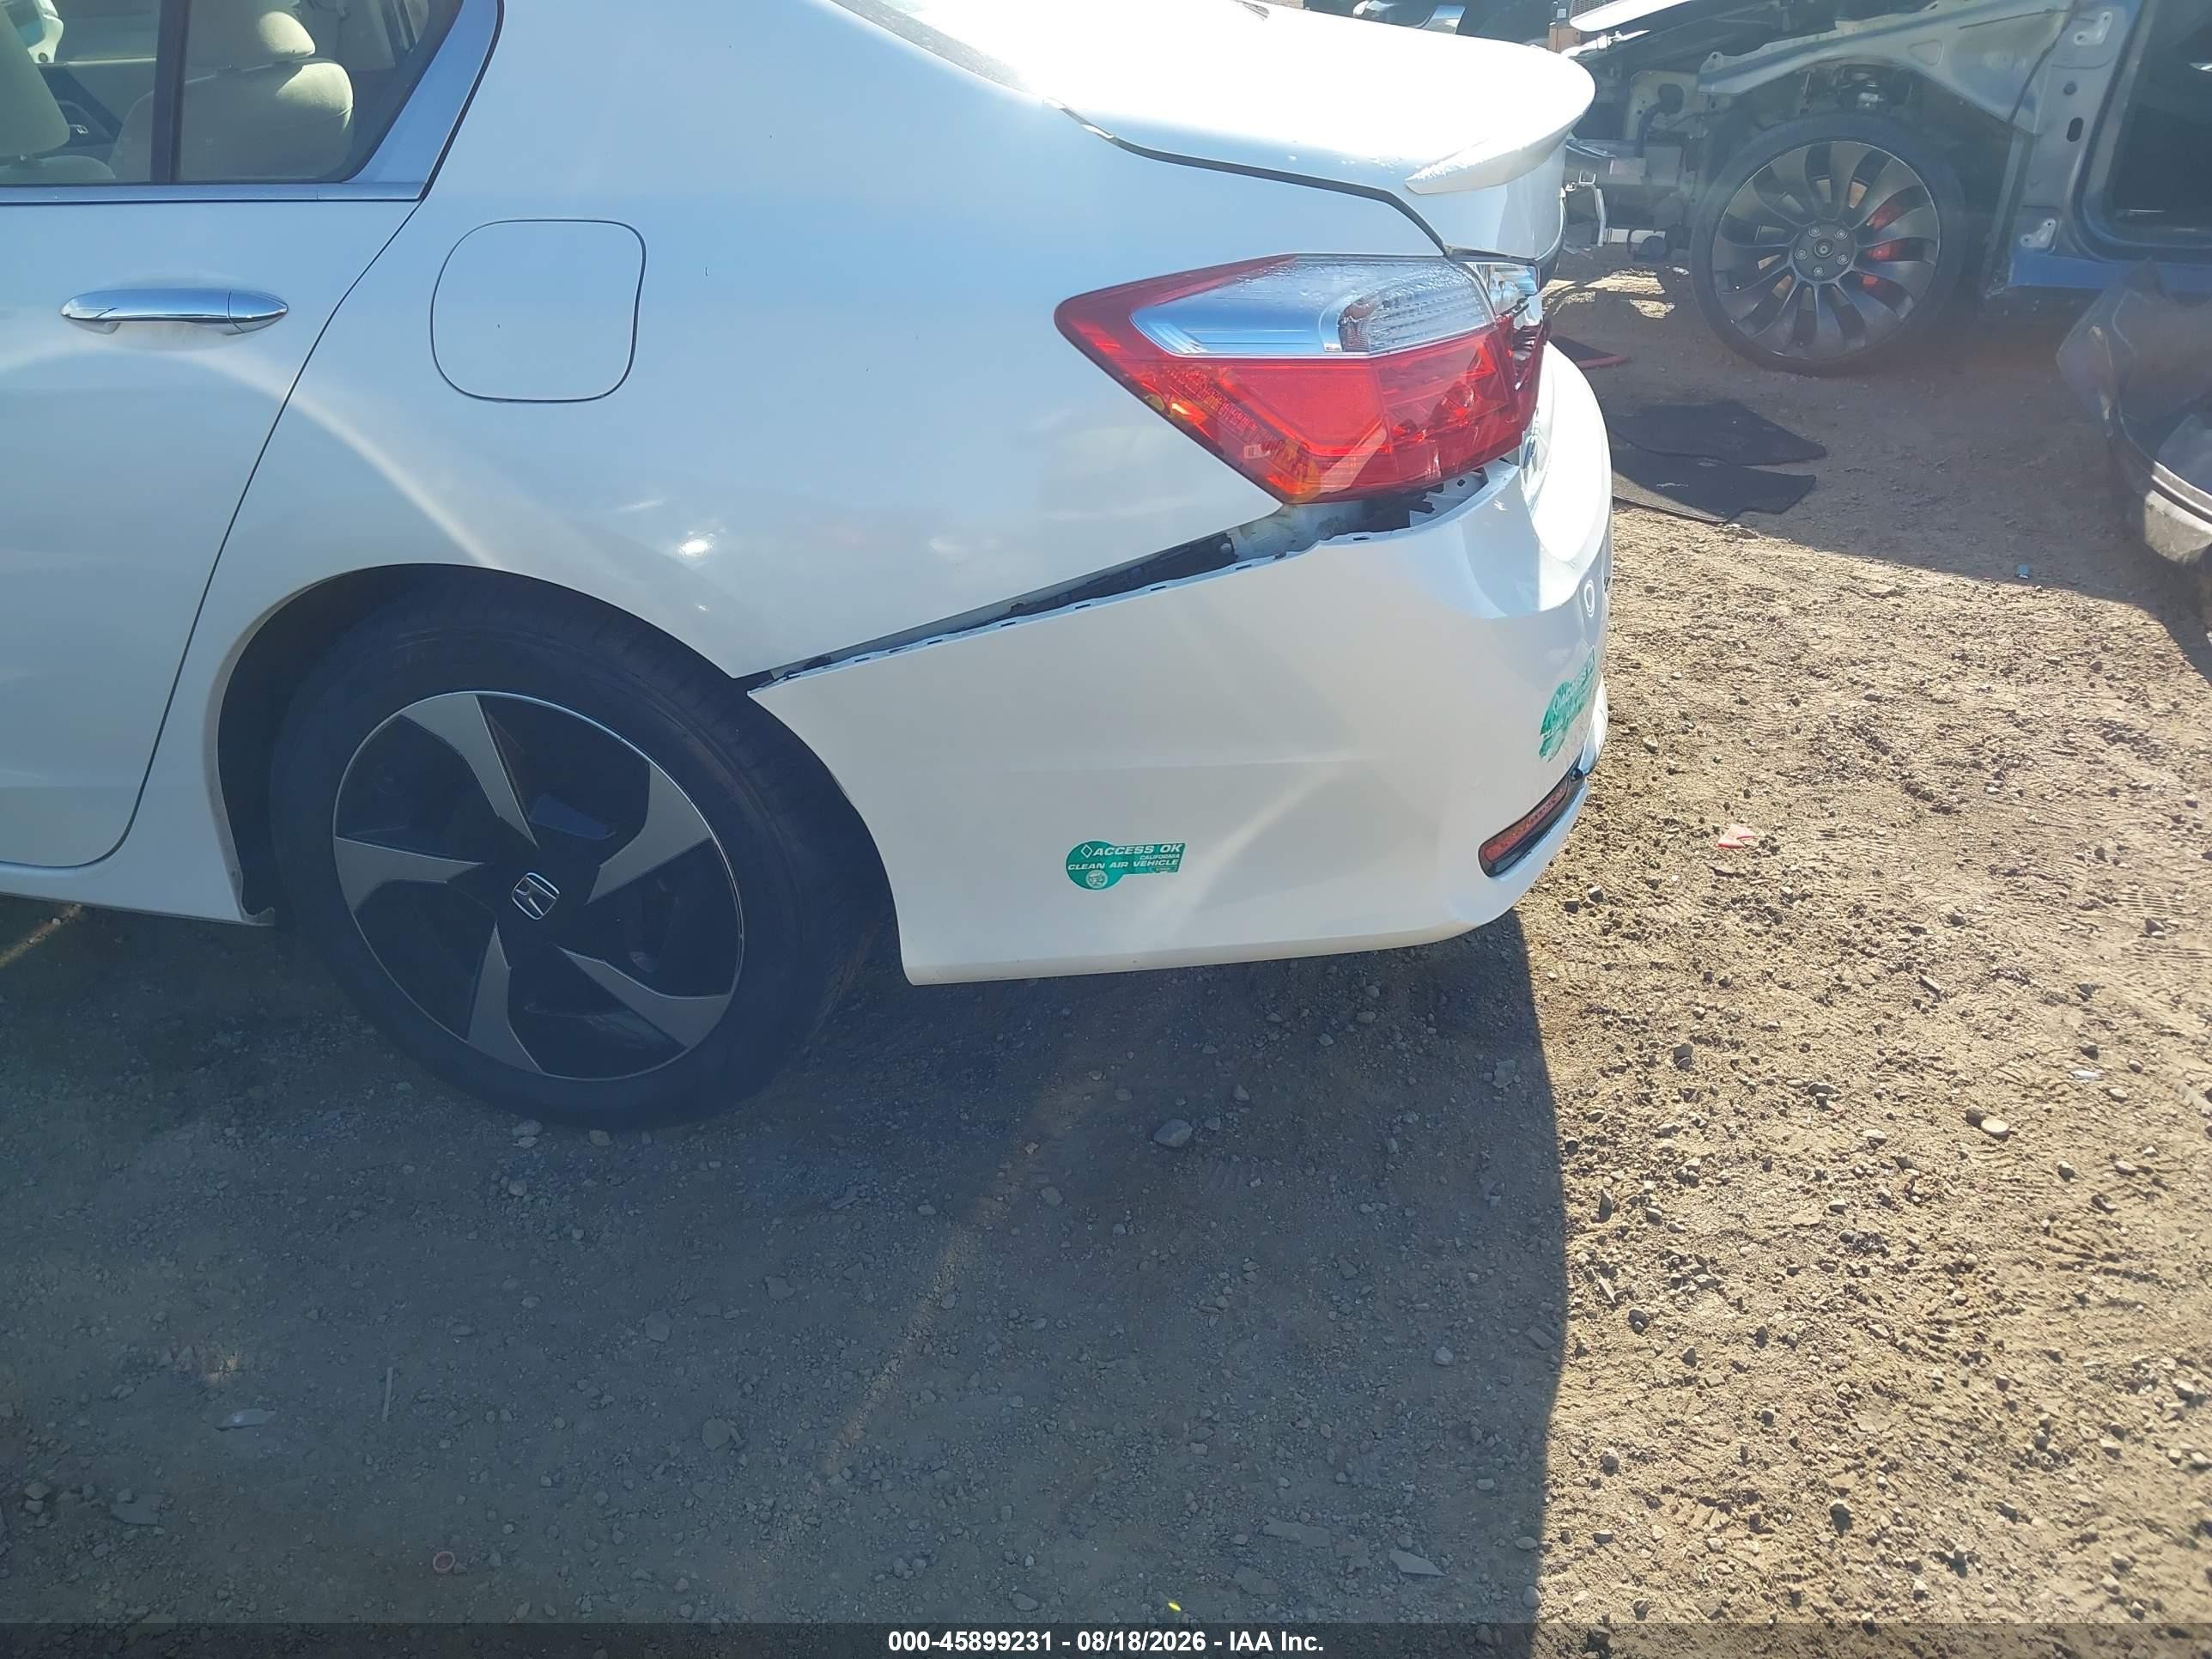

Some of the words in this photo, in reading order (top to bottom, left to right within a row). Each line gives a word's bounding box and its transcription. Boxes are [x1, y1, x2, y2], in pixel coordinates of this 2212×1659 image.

[1093, 845, 1155, 857] ACCESS
[1159, 844, 1182, 854] OK
[1067, 862, 1105, 871] CLEAN
[1133, 859, 1179, 867] VEHICLE
